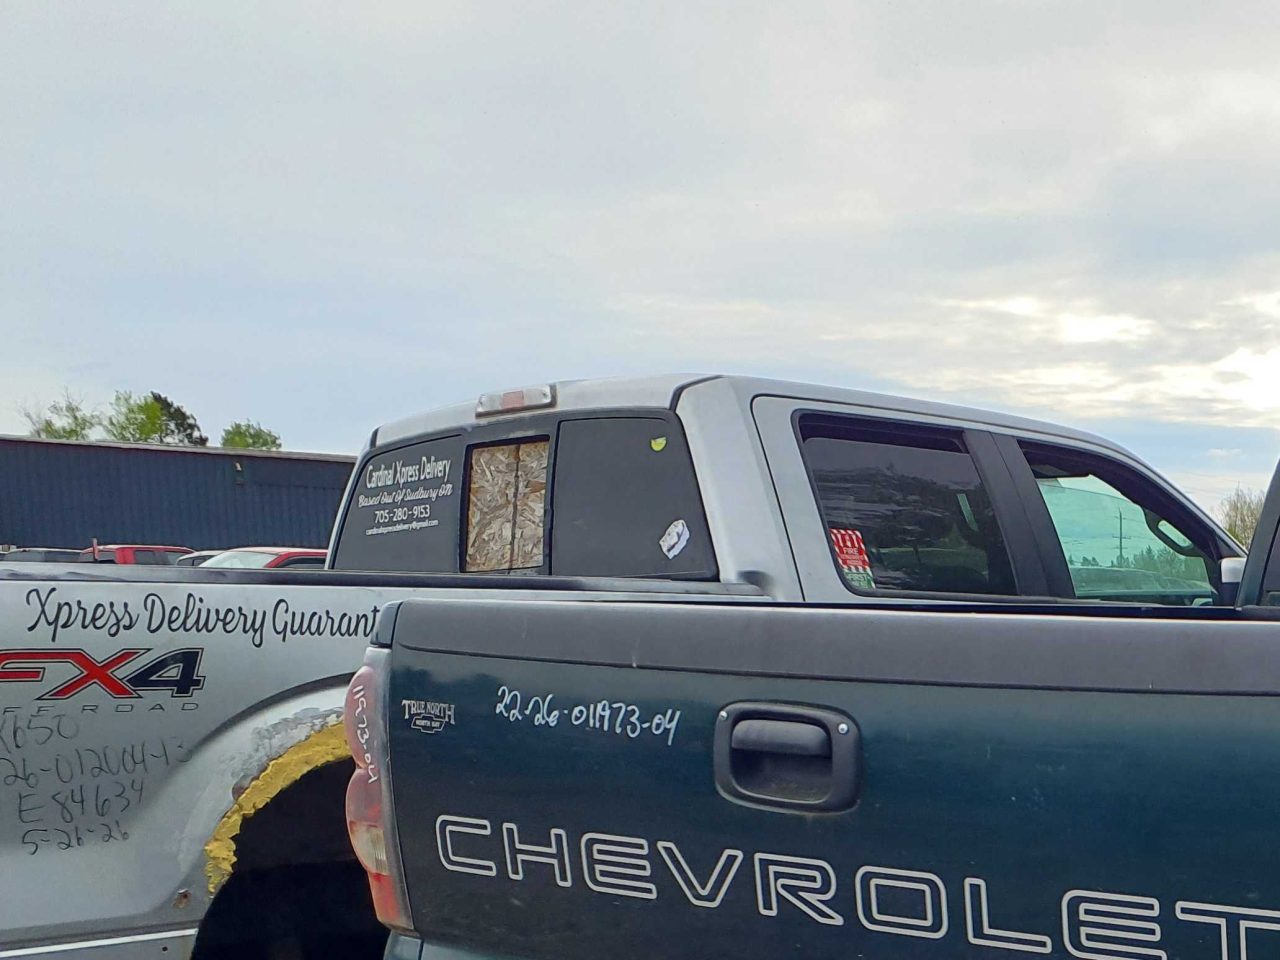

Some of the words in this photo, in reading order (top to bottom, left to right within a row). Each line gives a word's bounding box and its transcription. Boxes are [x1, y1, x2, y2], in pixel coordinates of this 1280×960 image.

[366, 462, 395, 488] Cardinal
[394, 460, 419, 487] Xpress
[420, 456, 451, 482] Delivery
[358, 493, 382, 508] Based
[380, 490, 395, 504] Out
[404, 486, 439, 501] Sudbury
[374, 504, 430, 523] 705-280-9153
[26, 588, 139, 642] Xpress
[143, 592, 267, 648] Delivery
[0, 647, 207, 701] FX4
[81, 702, 199, 714] ROAD
[401, 699, 426, 720] TRUE
[425, 701, 456, 725] NORTH
